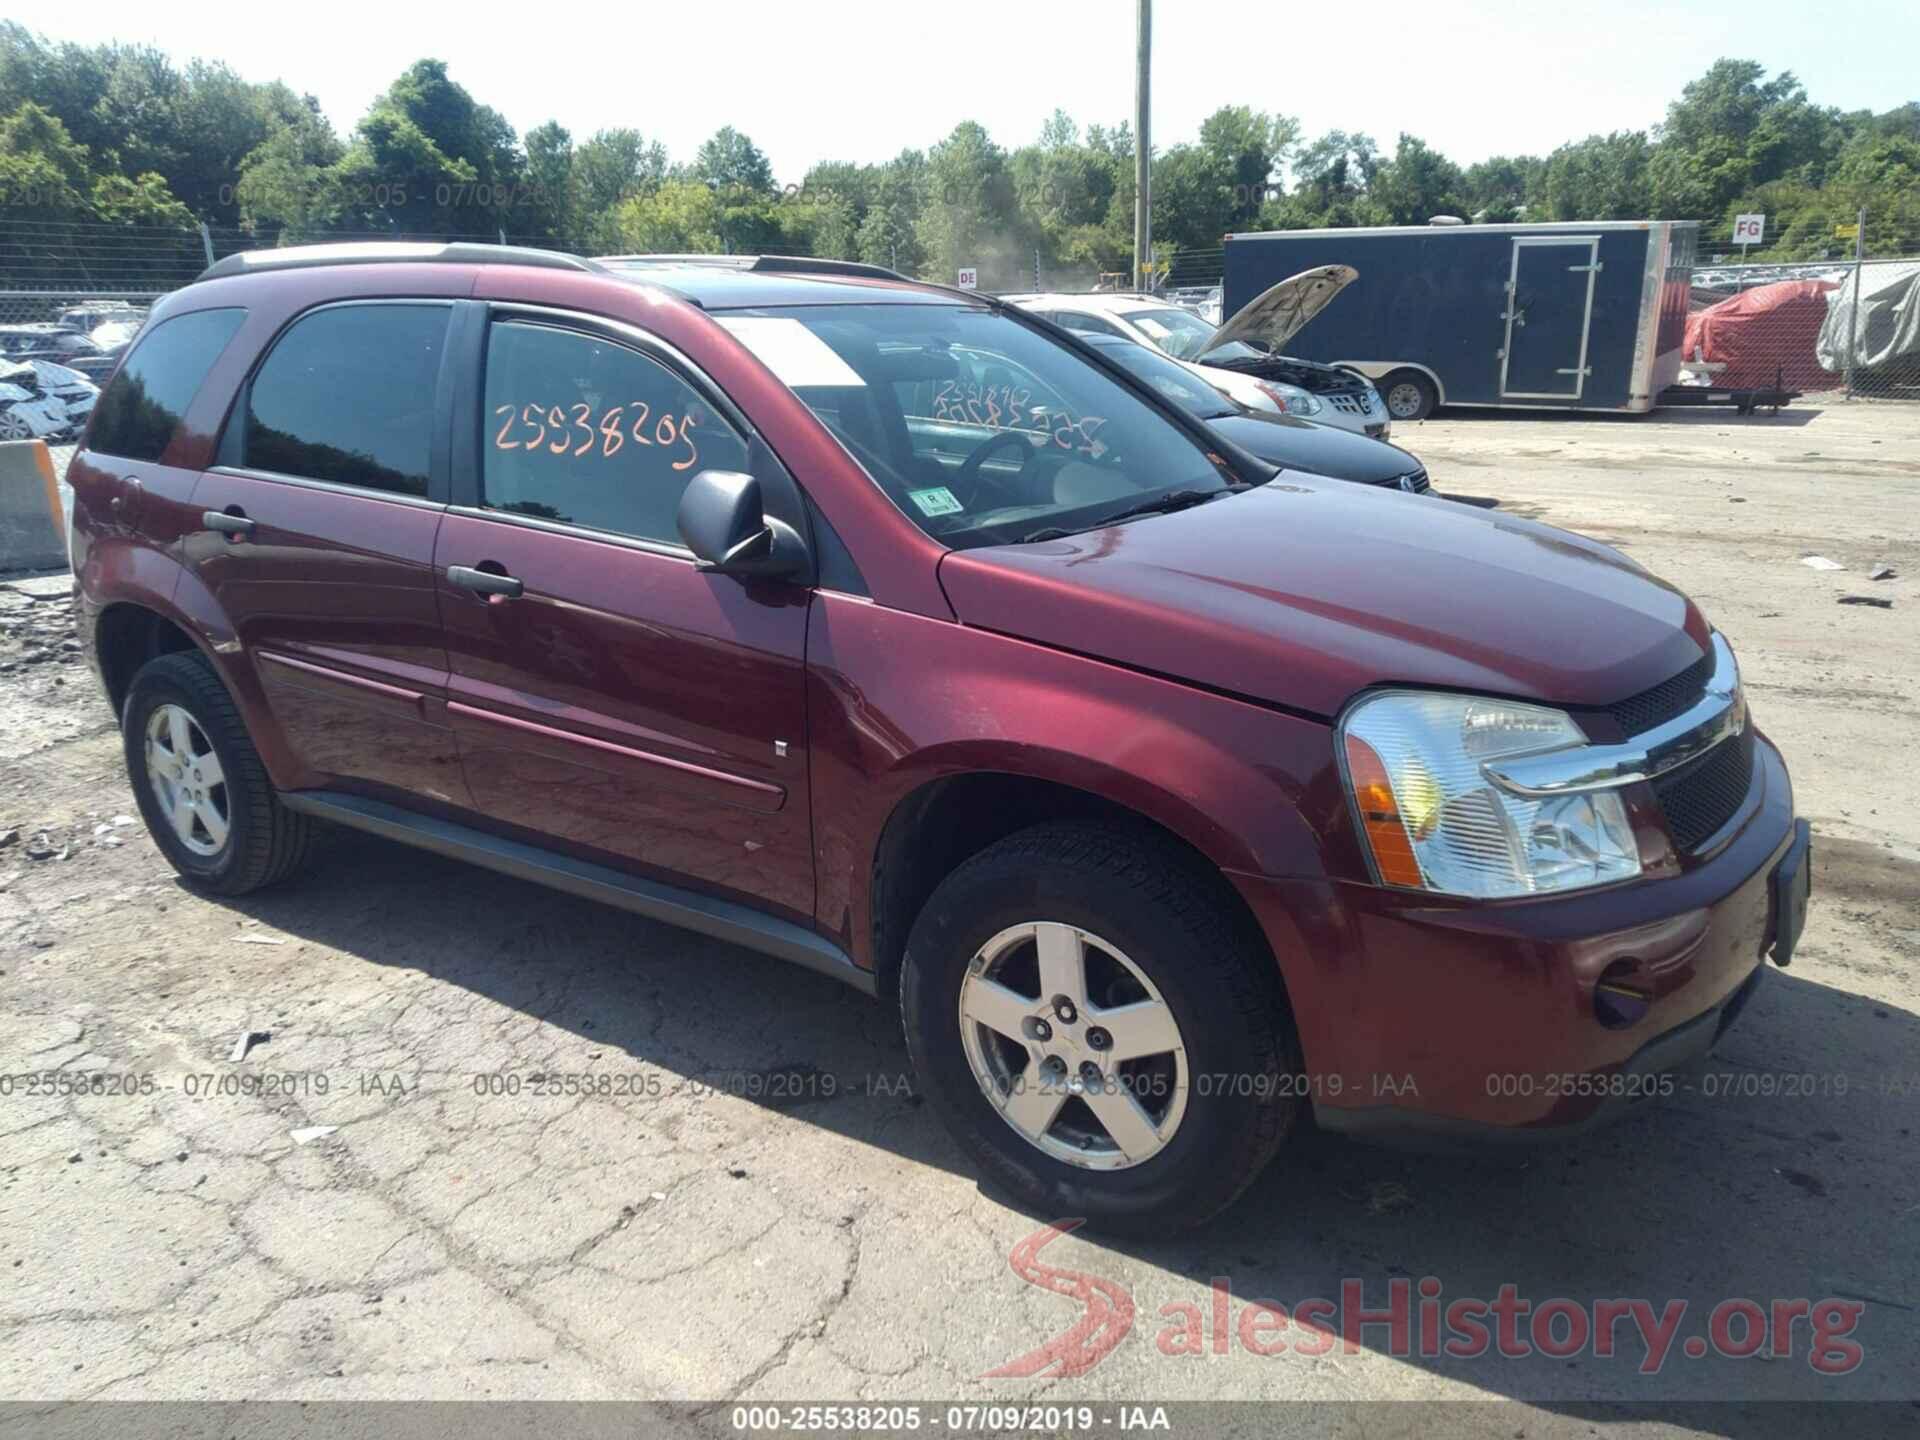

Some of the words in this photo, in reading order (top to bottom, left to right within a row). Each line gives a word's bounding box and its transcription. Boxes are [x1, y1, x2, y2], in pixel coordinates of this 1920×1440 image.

[1736, 220, 1760, 236] FG
[960, 272, 975, 284] DE
[495, 401, 697, 470] 25538205
